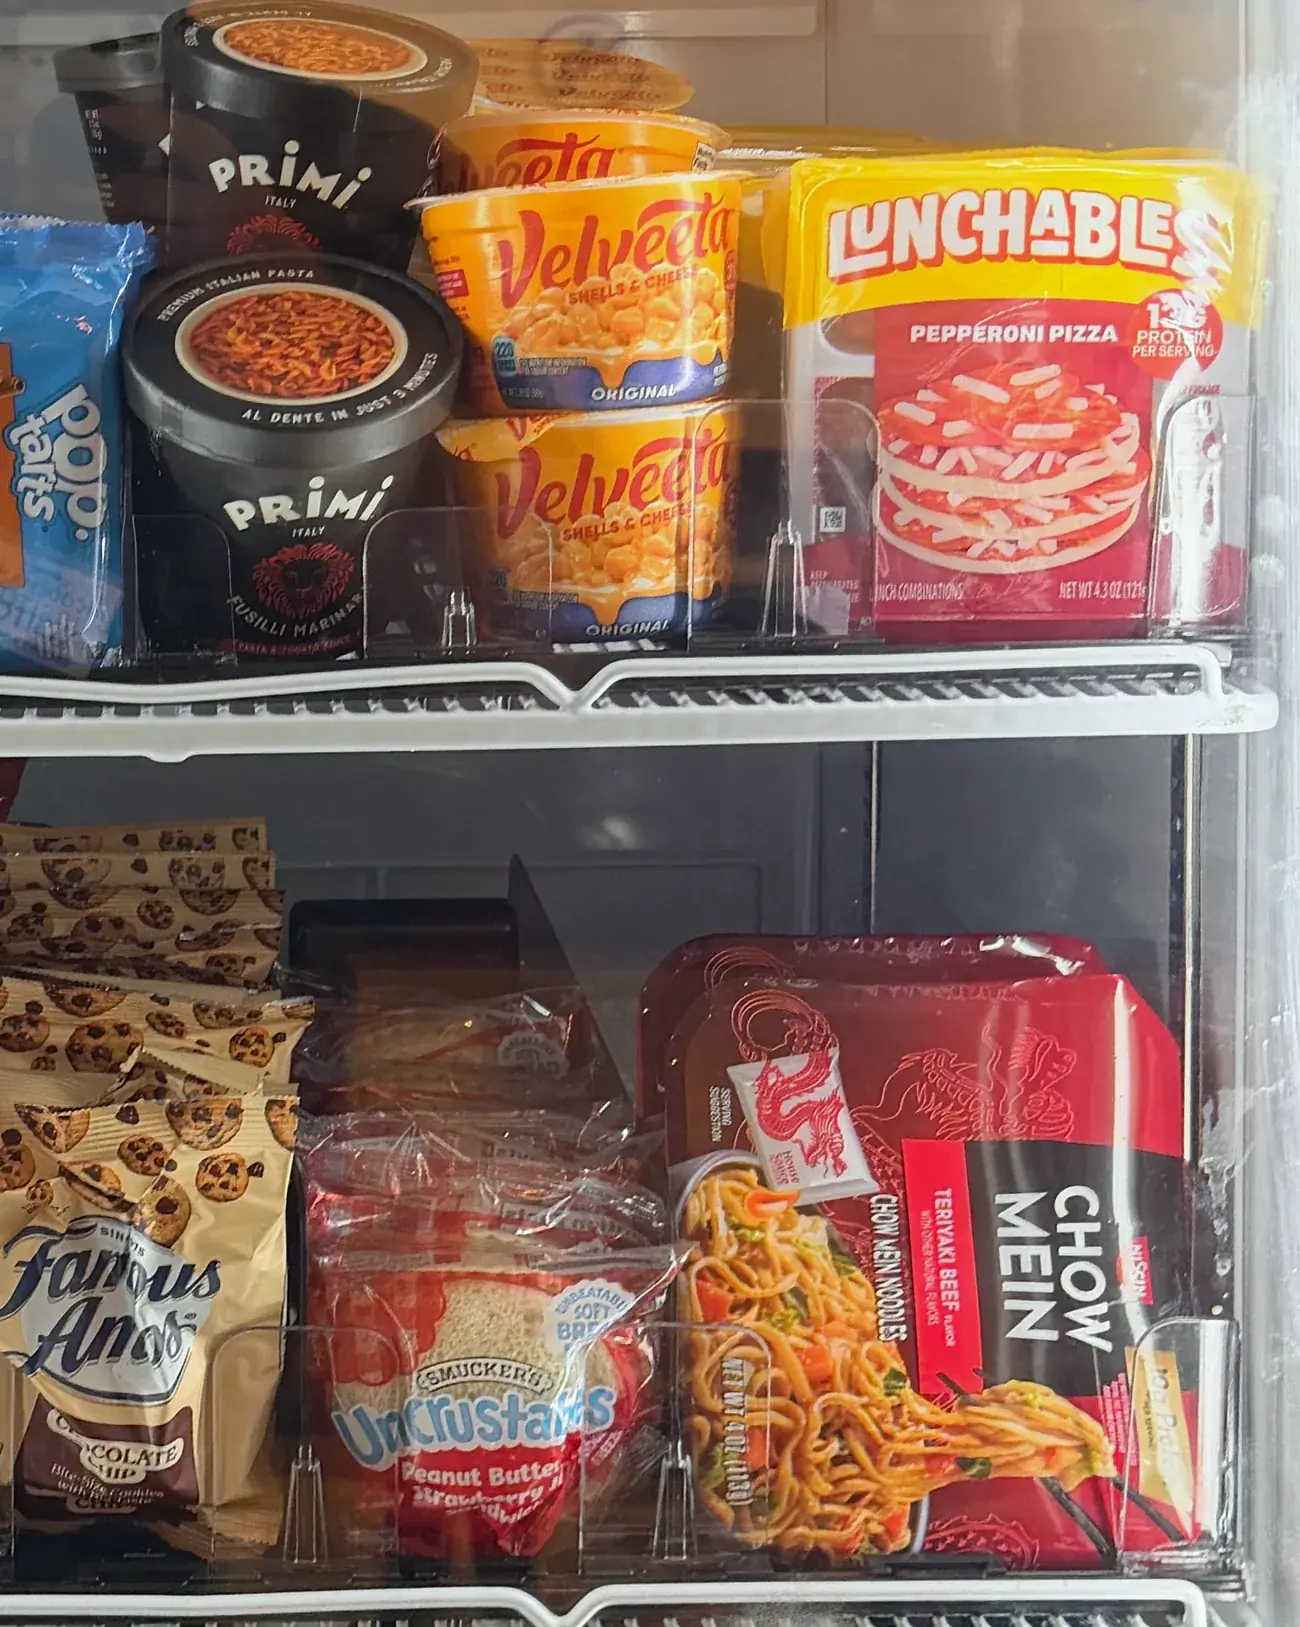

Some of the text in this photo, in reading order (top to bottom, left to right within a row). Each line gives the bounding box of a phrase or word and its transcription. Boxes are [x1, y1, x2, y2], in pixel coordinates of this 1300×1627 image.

[264, 195, 297, 210] ITALY
[825, 187, 1216, 285] LUNCHABLES
[497, 191, 736, 310] Velveeta
[157, 268, 315, 323] PREMIUM ITALIAN PASTA
[568, 281, 627, 306] SHELLS
[628, 279, 642, 294] &
[910, 324, 1118, 344] PEPPERONI PIZZA
[1136, 328, 1213, 345] PROTIN
[1131, 344, 1214, 359] PER SERVNG
[591, 383, 678, 402] ORIGINAL
[241, 408, 261, 421] AL
[270, 410, 325, 425] DENTE
[331, 409, 349, 421] IN
[355, 395, 392, 416] JUST
[495, 427, 730, 540] Velveeta
[292, 525, 326, 539] ITALY
[561, 518, 619, 542] SHELLS
[624, 517, 636, 531] &
[898, 582, 964, 602] COMBINATIONS
[1059, 580, 1077, 600] NET
[1078, 580, 1093, 600] WT
[1093, 580, 1108, 600] 4.3
[1109, 580, 1122, 599] OZ
[226, 592, 365, 637] FUSILLI MARINAR
[584, 619, 669, 637] ORIGINAL
[721, 1086, 732, 1126] SERVING
[869, 1194, 908, 1342] CHOW MEIN NOODLES
[923, 1257, 937, 1291] NATURAL
[934, 1188, 961, 1347] TERIYAKI BEEF FLAVOR
[994, 1191, 1060, 1342] MEIN
[1054, 1185, 1113, 1353] CHOW
[1130, 1243, 1149, 1298] NISSIN
[574, 1302, 611, 1319] SOFT
[926, 1292, 940, 1326] FLAVORS
[557, 1321, 610, 1341] BRE
[429, 1361, 544, 1389] SMUCKER'S
[721, 1356, 745, 1387] NET
[723, 1391, 747, 1417] WT
[724, 1421, 747, 1431] 4
[724, 1435, 748, 1454] OZ
[402, 1461, 482, 1487] Peanut
